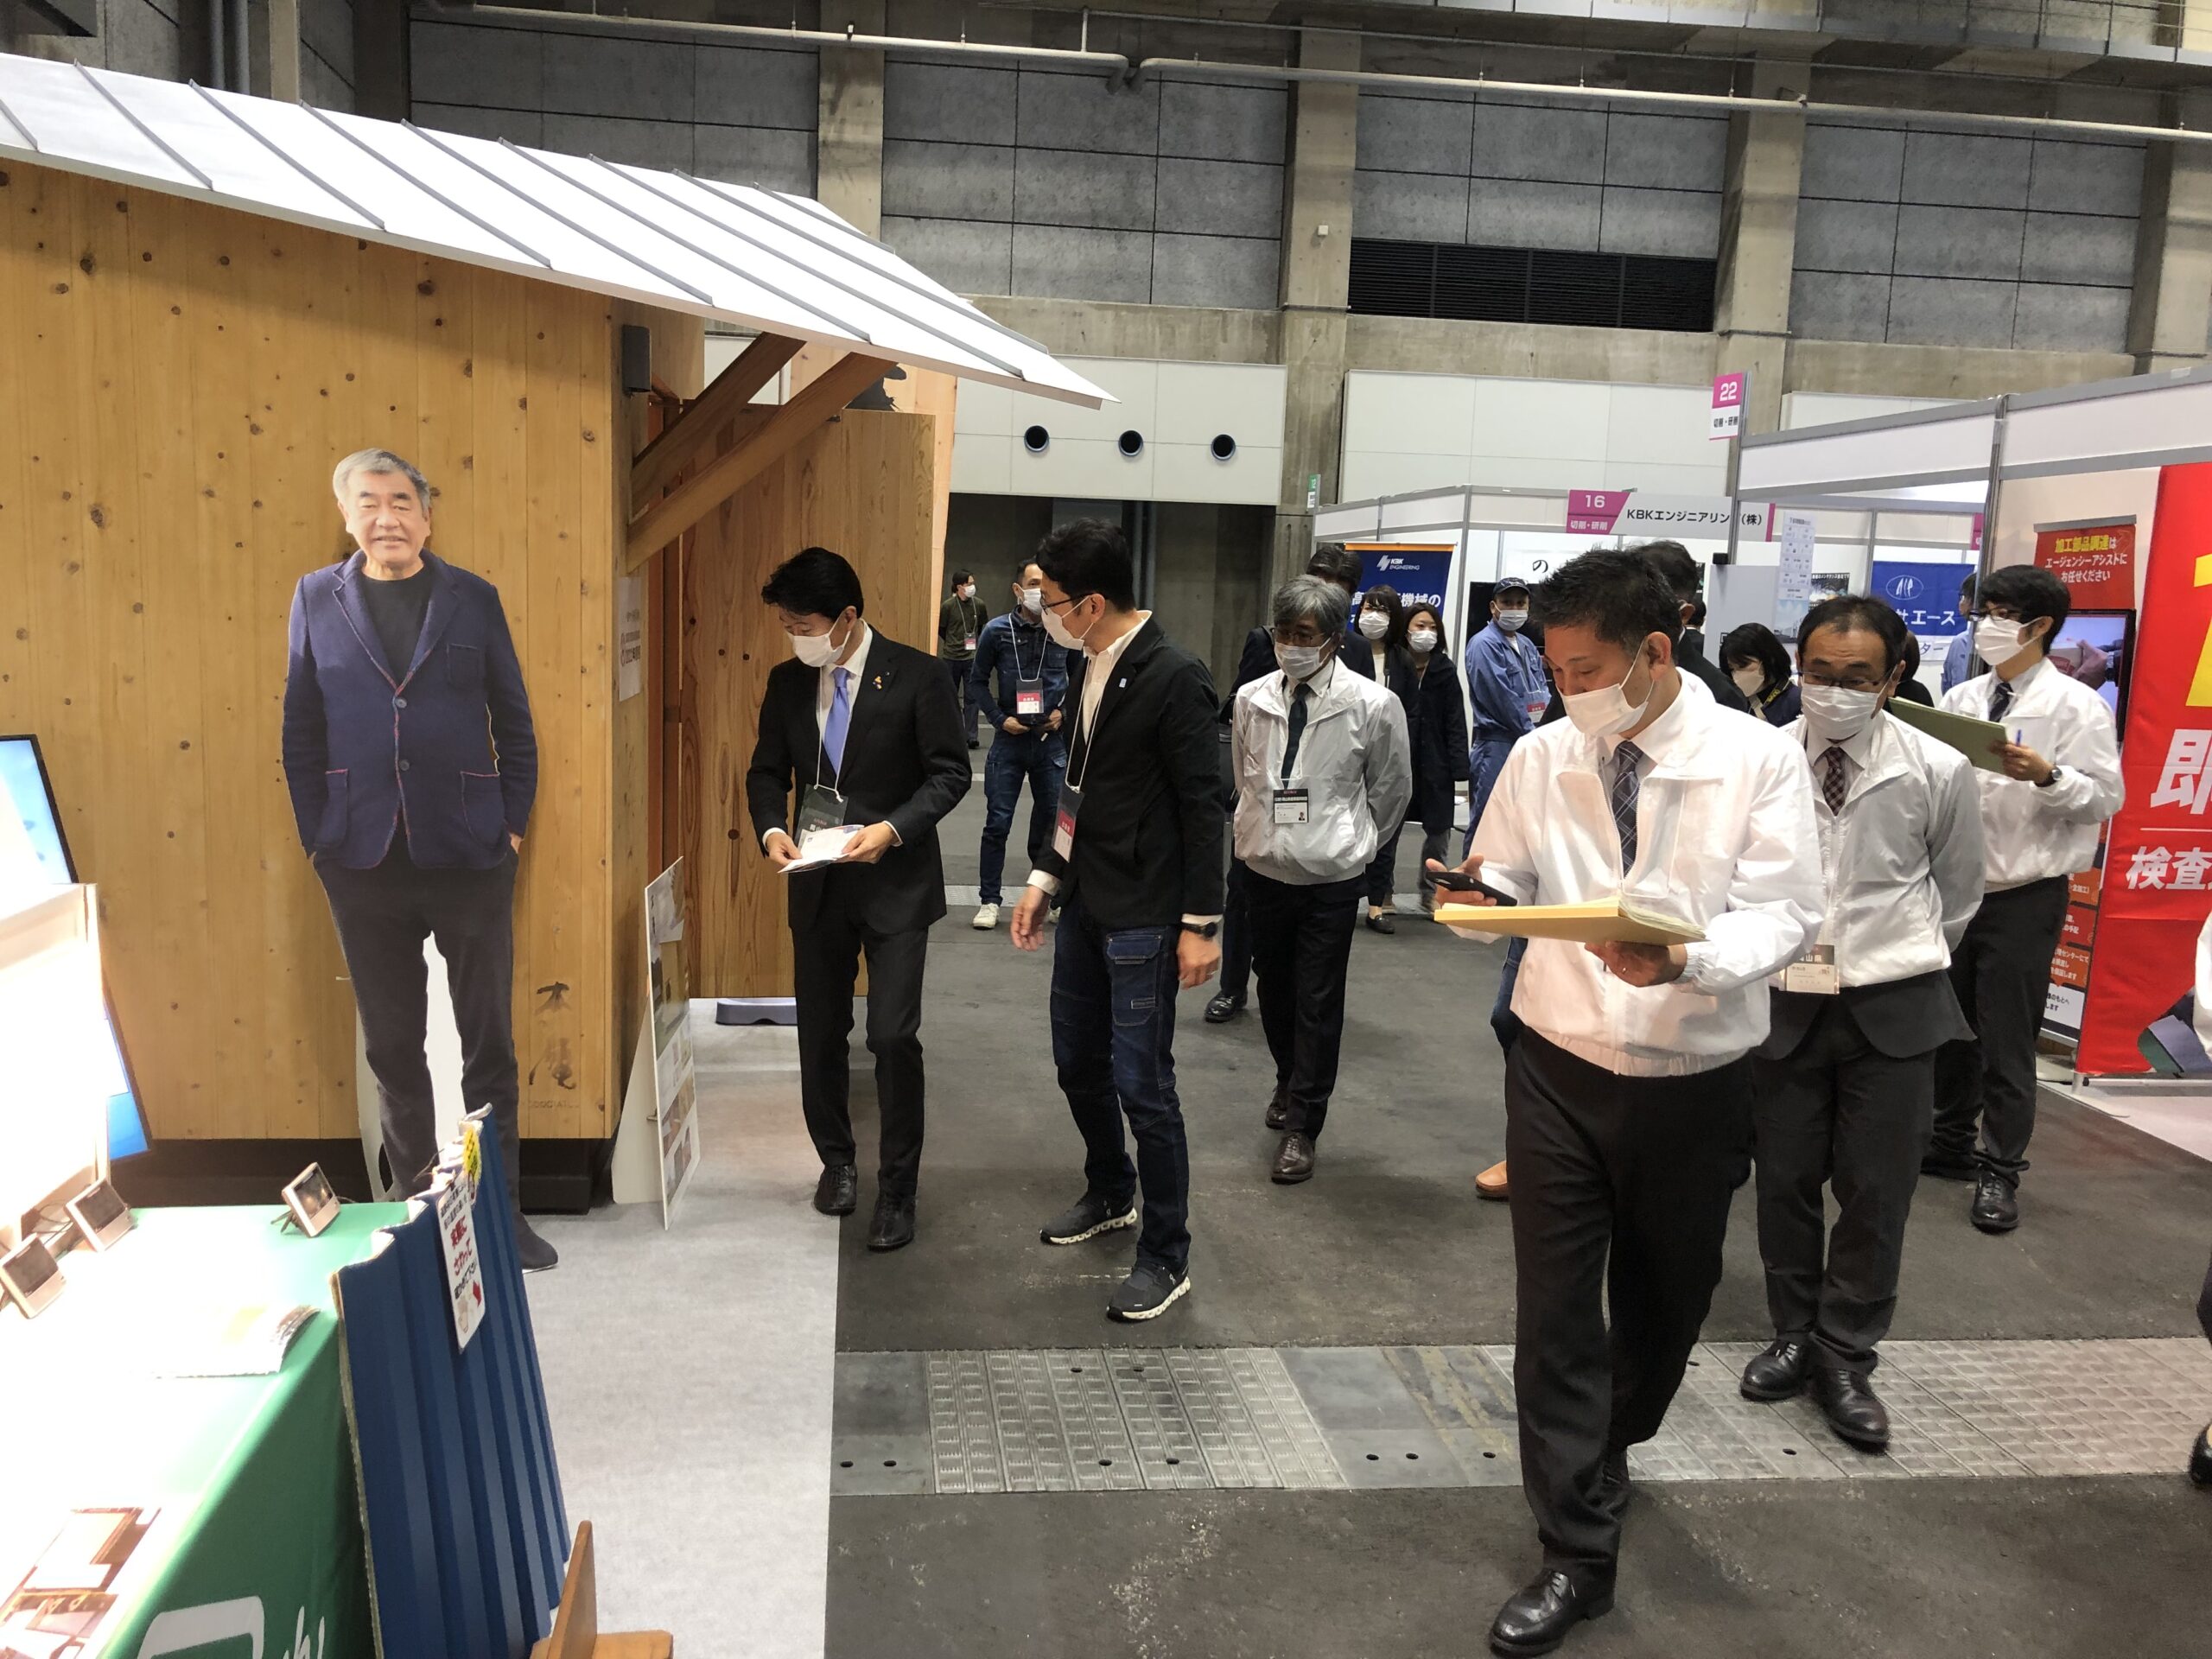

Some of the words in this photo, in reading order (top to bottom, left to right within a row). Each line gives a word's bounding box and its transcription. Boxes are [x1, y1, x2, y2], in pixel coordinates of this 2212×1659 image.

[1719, 381, 1738, 402] 22
[1585, 495, 1605, 508] 16
[1627, 509, 1763, 525] KBKエンジニアリン（株）
[2055, 534, 2117, 553] 加工部品調達は
[2045, 553, 2128, 568] エージェンシーアシストに
[2061, 569, 2111, 582] お任せください
[2126, 845, 2212, 891] 検査
